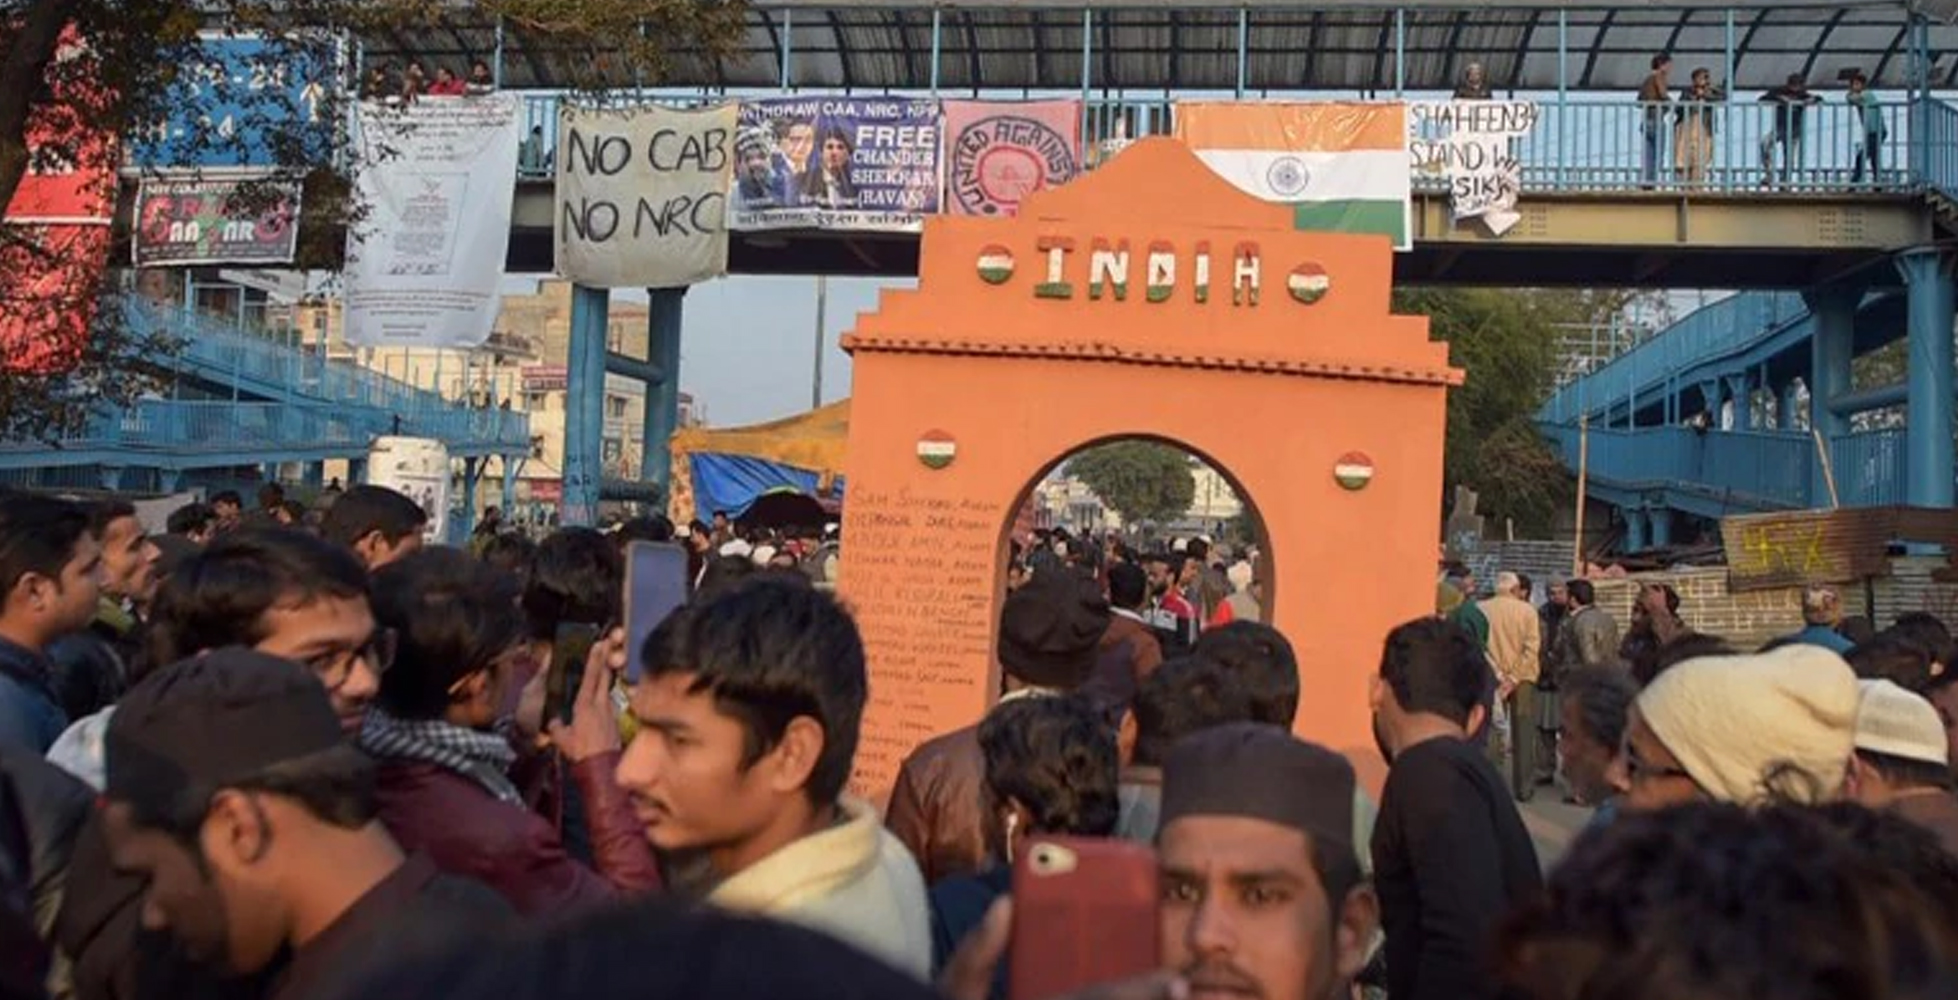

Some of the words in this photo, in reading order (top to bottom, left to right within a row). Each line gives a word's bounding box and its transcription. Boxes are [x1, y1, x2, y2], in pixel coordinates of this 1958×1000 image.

[566, 127, 632, 176] NO
[649, 127, 728, 173] CAB
[852, 149, 935, 167] CHANDER
[855, 124, 936, 148] FREE
[1409, 141, 1485, 171] STAND
[958, 129, 991, 207] UNITED
[562, 196, 620, 243] NO
[633, 191, 726, 238] NRC
[1034, 234, 1261, 307] INDIA
